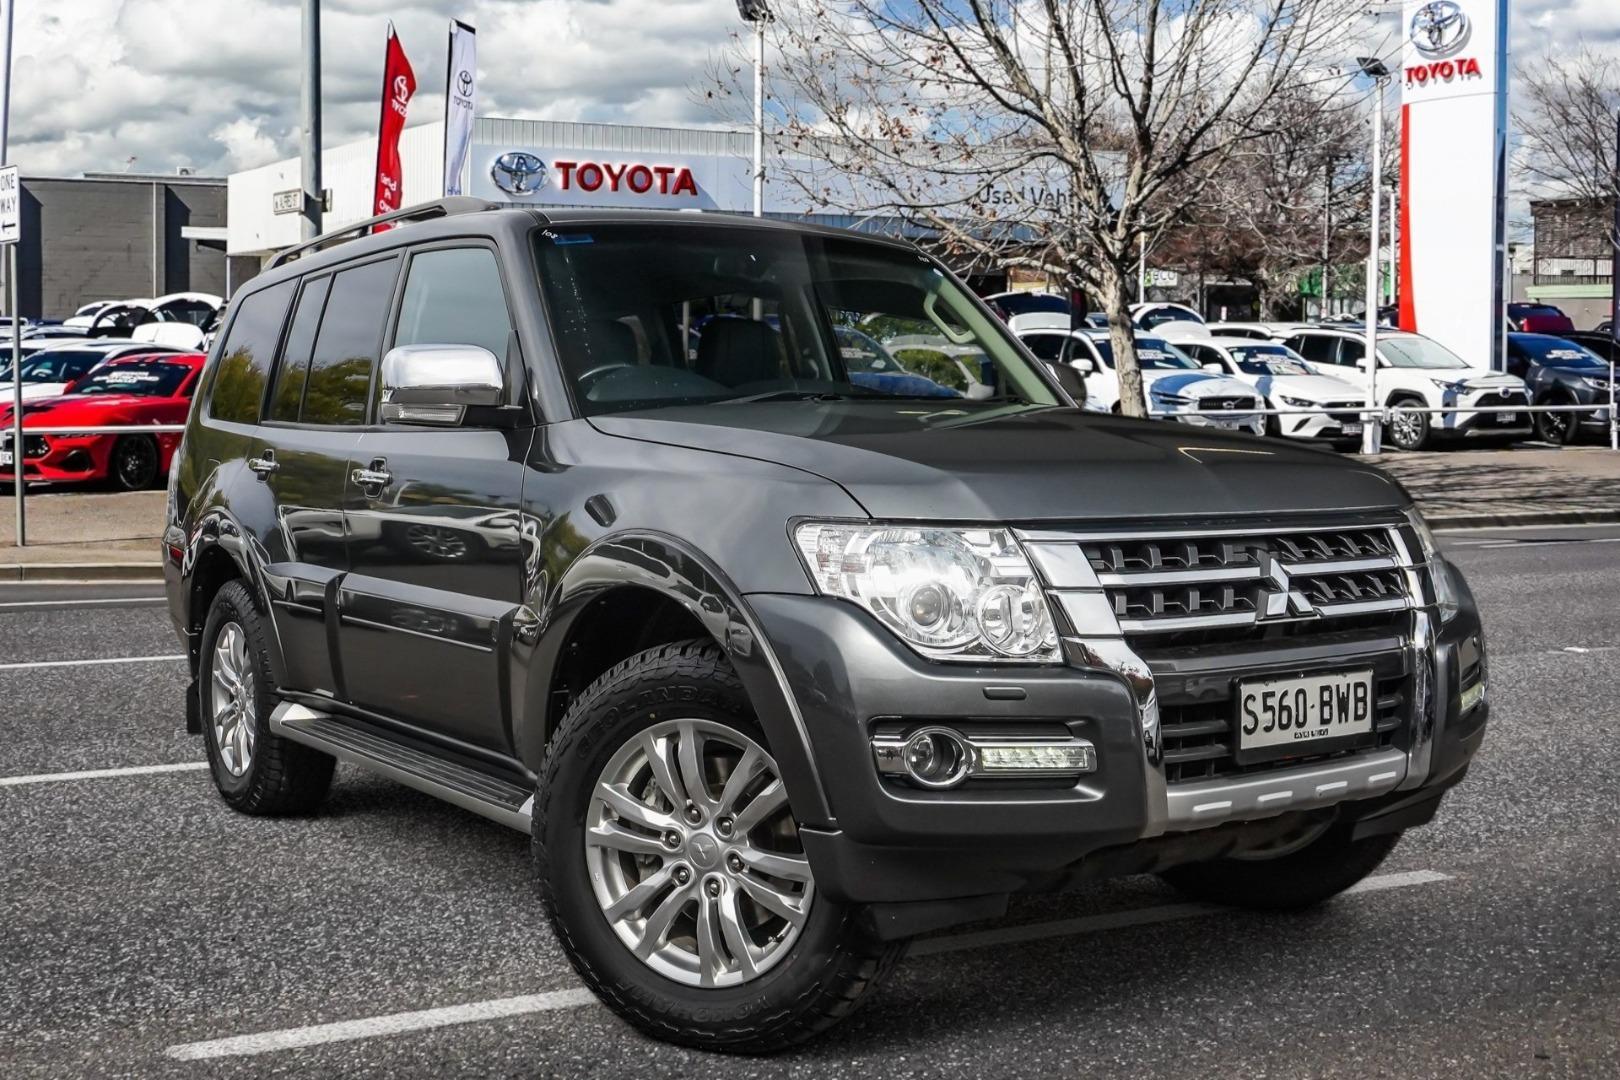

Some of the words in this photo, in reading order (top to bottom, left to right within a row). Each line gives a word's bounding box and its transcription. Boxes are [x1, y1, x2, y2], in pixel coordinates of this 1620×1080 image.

[1404, 58, 1480, 83] TOYOTA
[0, 173, 15, 191] ONE
[555, 161, 698, 196] TOYOTA
[0, 196, 16, 214] WAY
[980, 183, 1025, 205] Used
